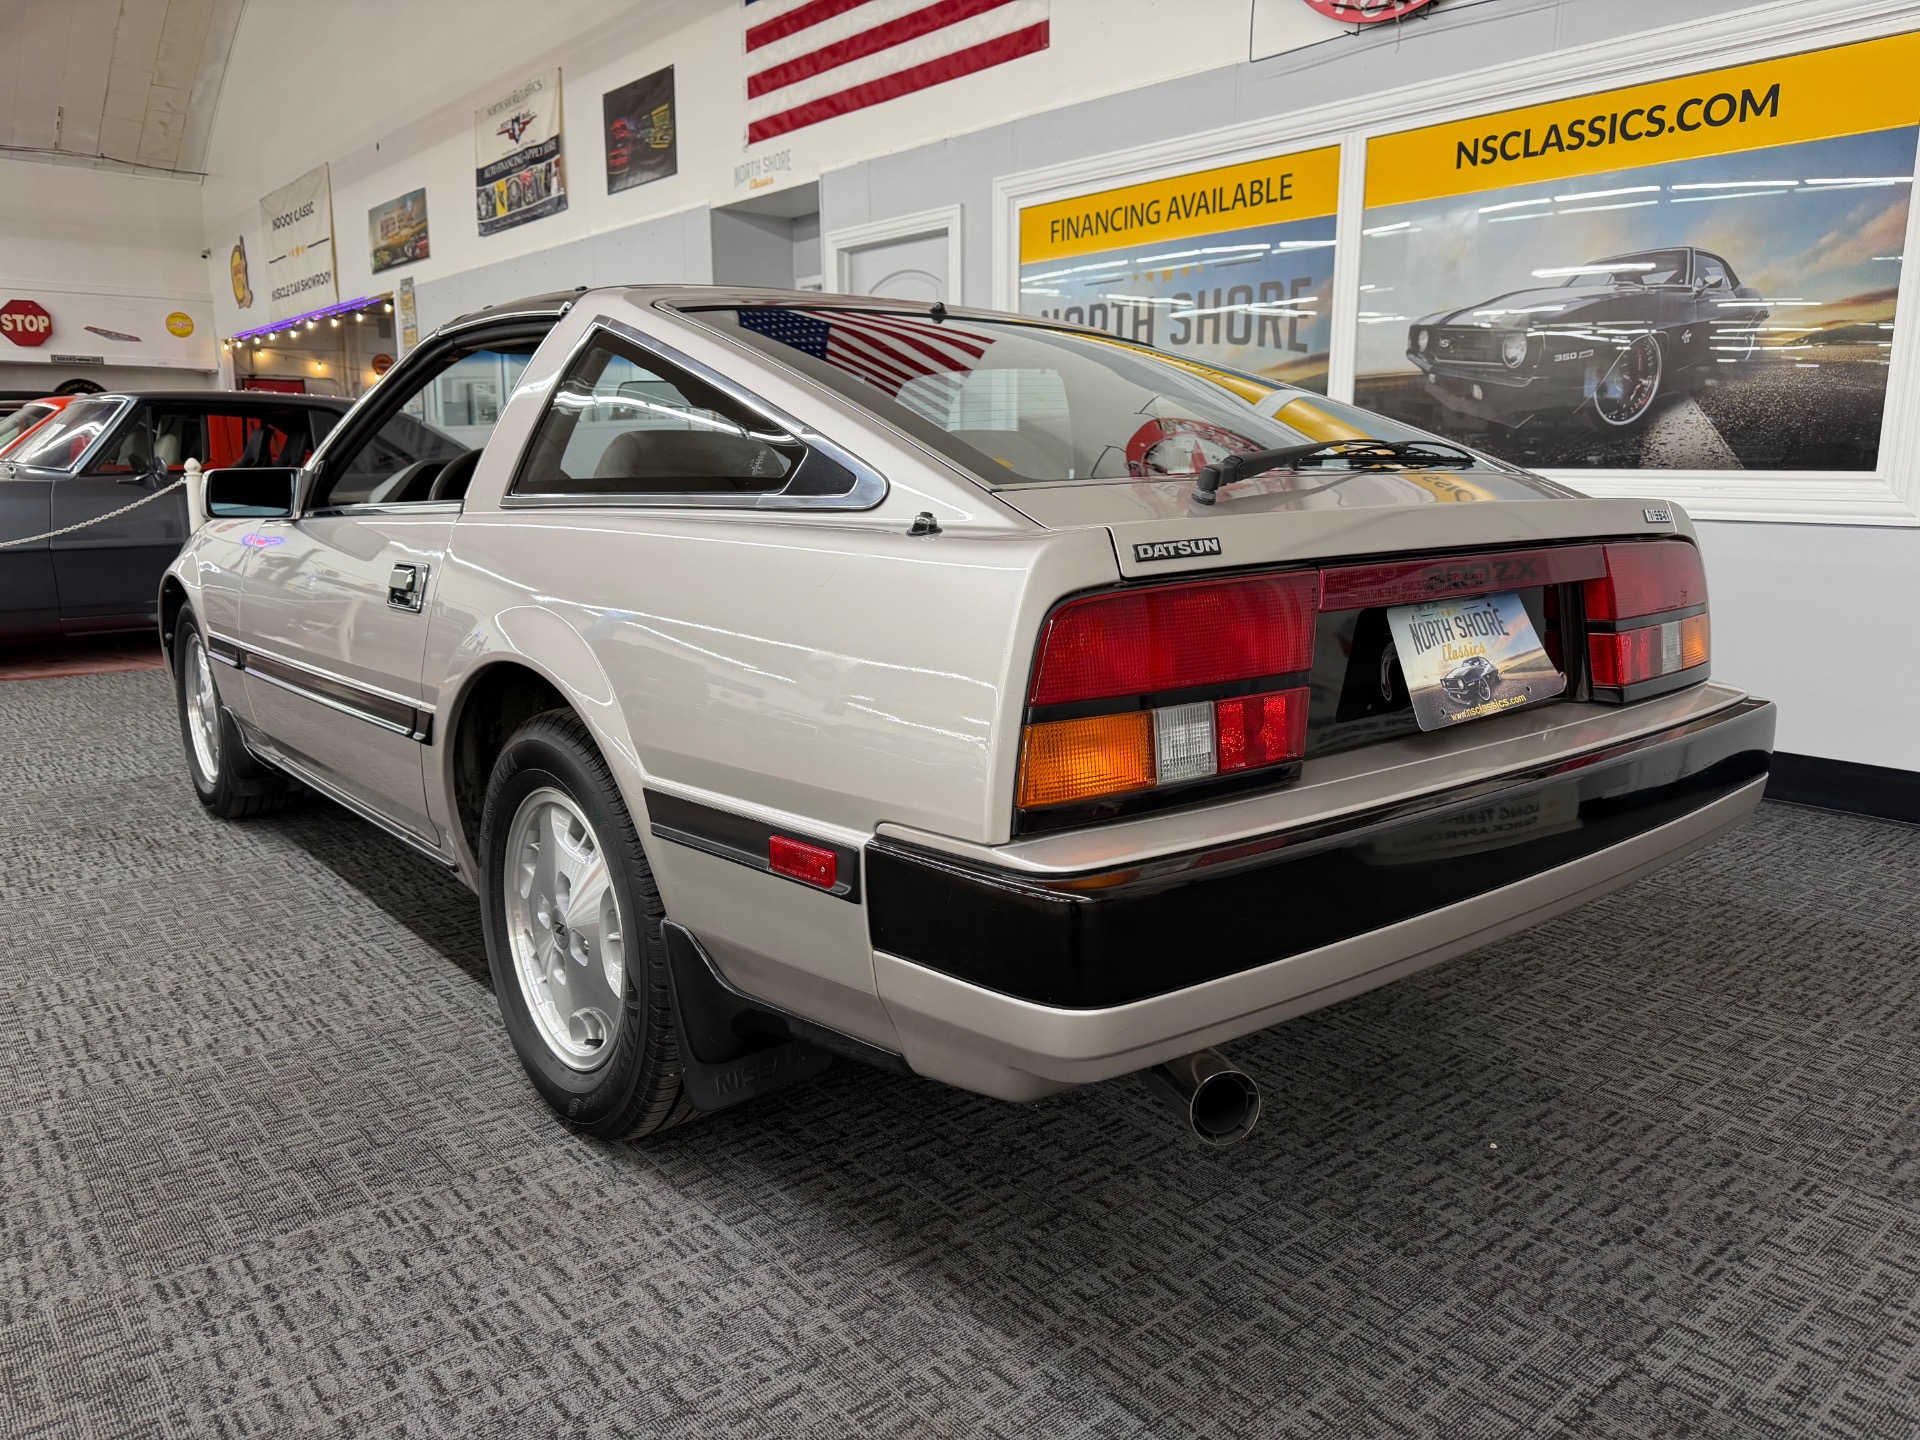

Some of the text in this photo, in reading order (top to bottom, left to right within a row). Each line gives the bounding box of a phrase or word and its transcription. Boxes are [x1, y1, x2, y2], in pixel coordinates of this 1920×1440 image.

[1455, 83, 1781, 170] NSCLASSICS.COM
[734, 149, 792, 188] NORTH SHORE
[1050, 173, 1294, 244] FINANCING AVAILABLE
[0, 313, 50, 333] STOP
[1169, 276, 1312, 353] SHORE
[1554, 351, 1577, 362] 350
[1137, 539, 1220, 559] DATSUN
[1408, 608, 1510, 656] NORTH SHORE
[1441, 641, 1487, 662] Classics
[1450, 694, 1527, 722] www.nsclassics.com
